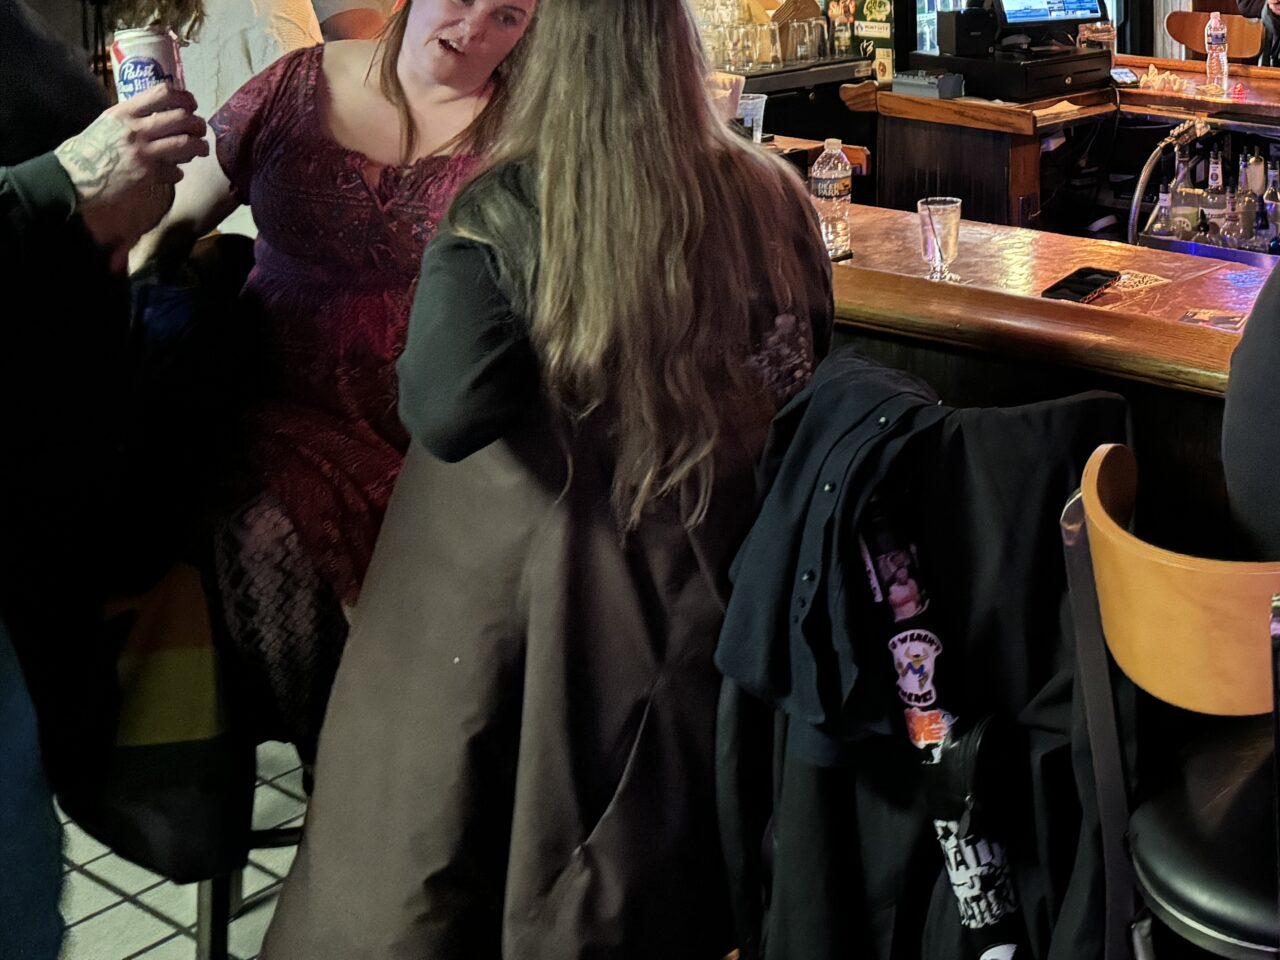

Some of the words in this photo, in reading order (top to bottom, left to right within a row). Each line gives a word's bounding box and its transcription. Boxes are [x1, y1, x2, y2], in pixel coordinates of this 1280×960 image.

[121, 63, 156, 81] Pabst
[817, 182, 838, 190] DEER
[817, 189, 840, 197] PARK
